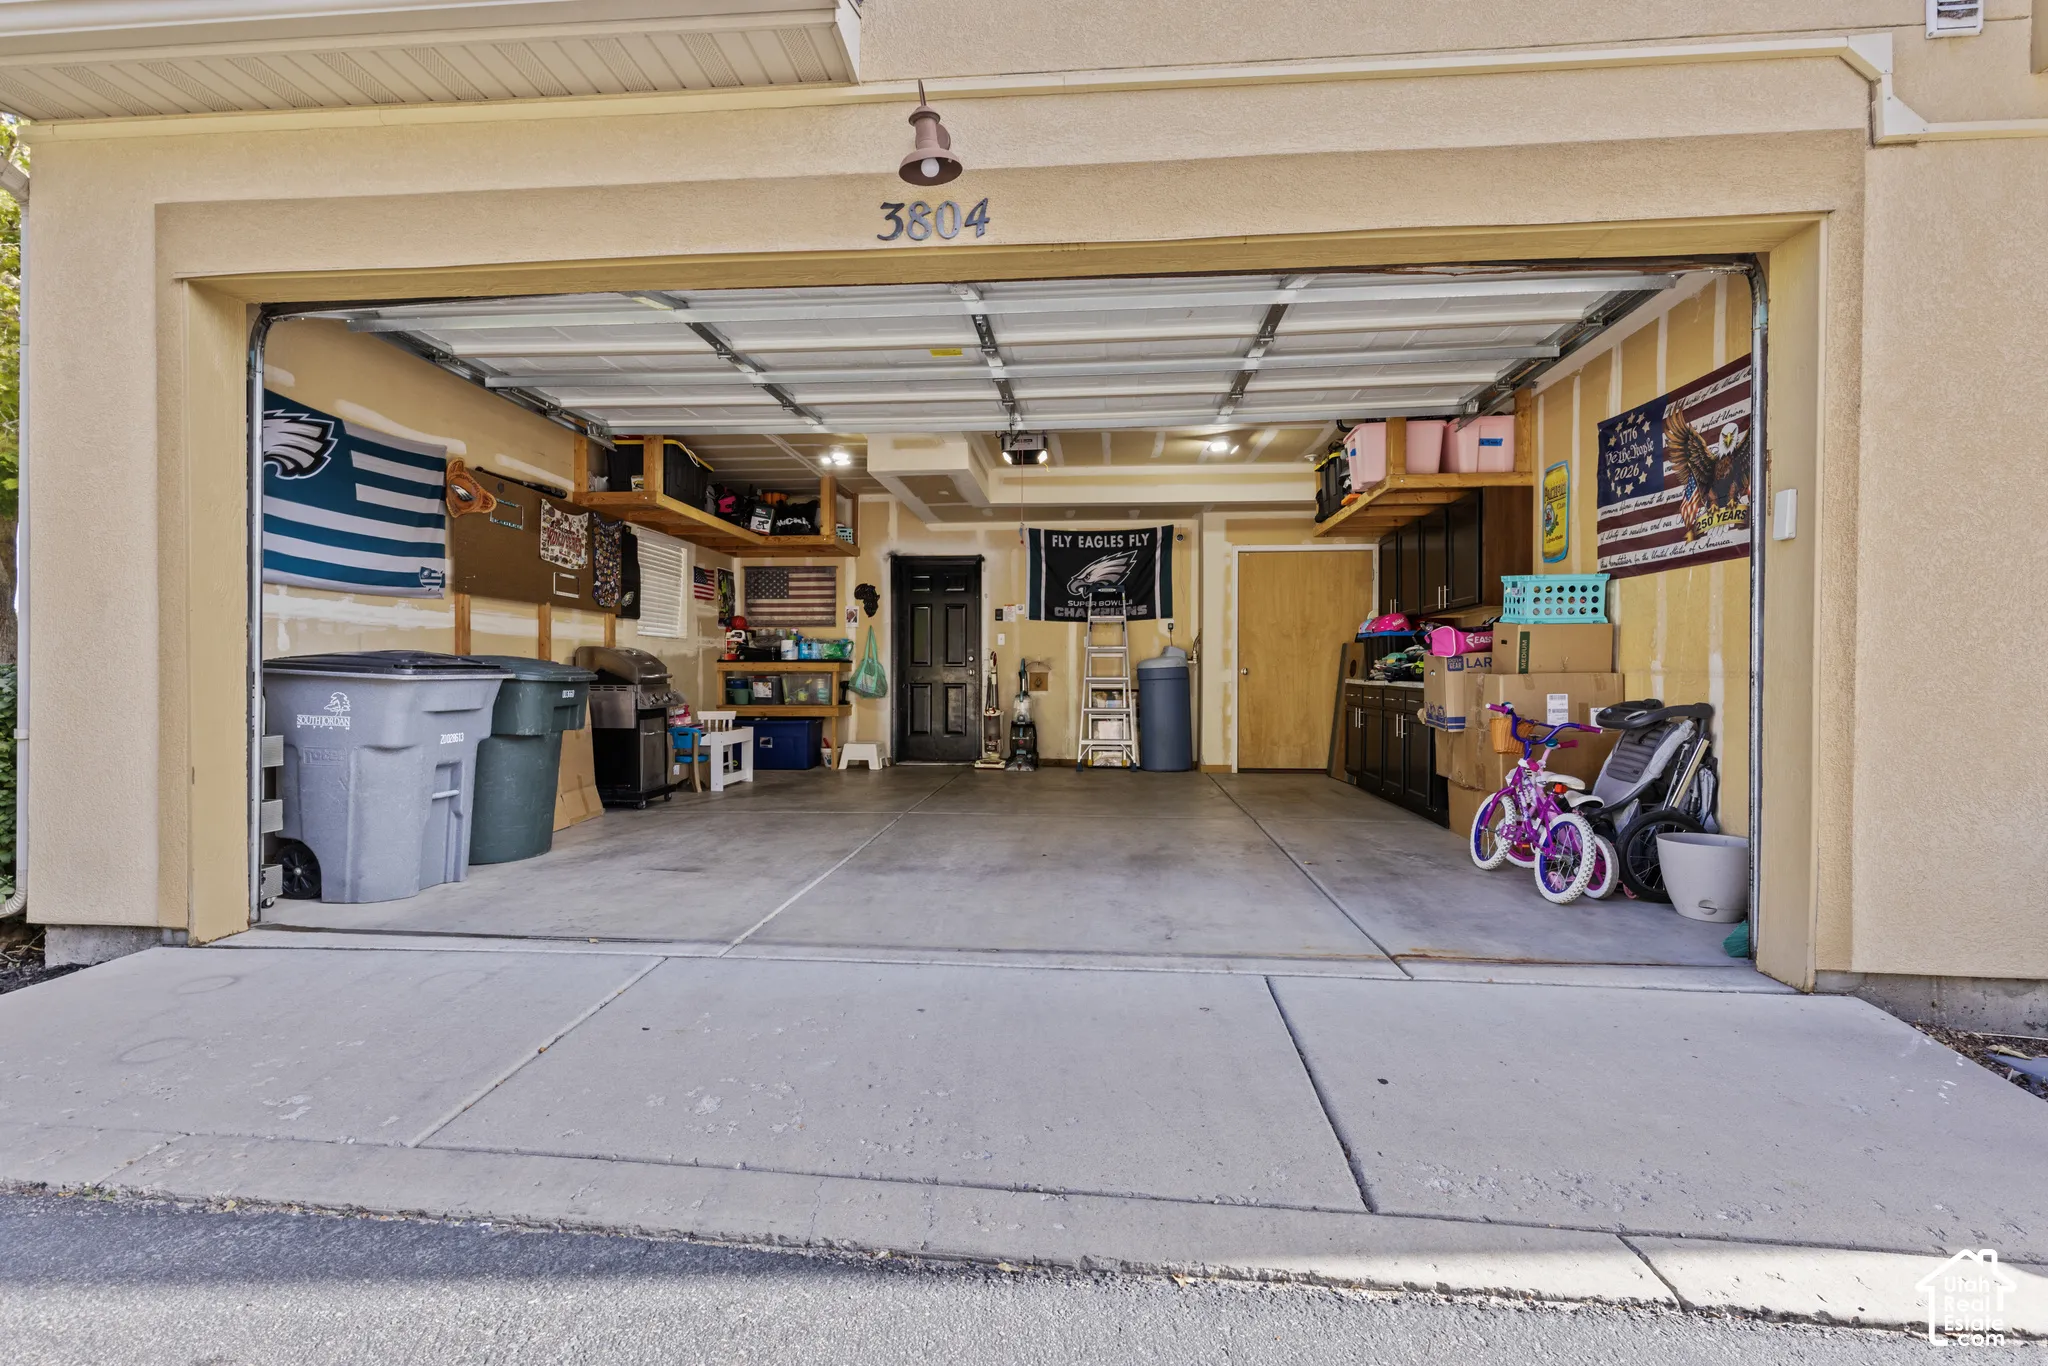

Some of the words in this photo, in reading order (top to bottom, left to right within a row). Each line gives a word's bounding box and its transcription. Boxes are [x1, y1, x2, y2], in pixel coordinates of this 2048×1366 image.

[877, 198, 990, 241] 3804
[1620, 426, 1638, 445] 1776
[1630, 437, 1655, 459] People
[1614, 463, 1640, 481] 2026
[1696, 517, 1713, 533] 250
[1716, 509, 1747, 524] YEARS
[1052, 535, 1073, 549] FLY
[1078, 535, 1124, 549] EAGLES
[1129, 533, 1150, 547] FLY
[1054, 605, 1148, 618] CHAMPIONS
[297, 714, 320, 725] SOUTH
[320, 715, 351, 727] JORDAN
